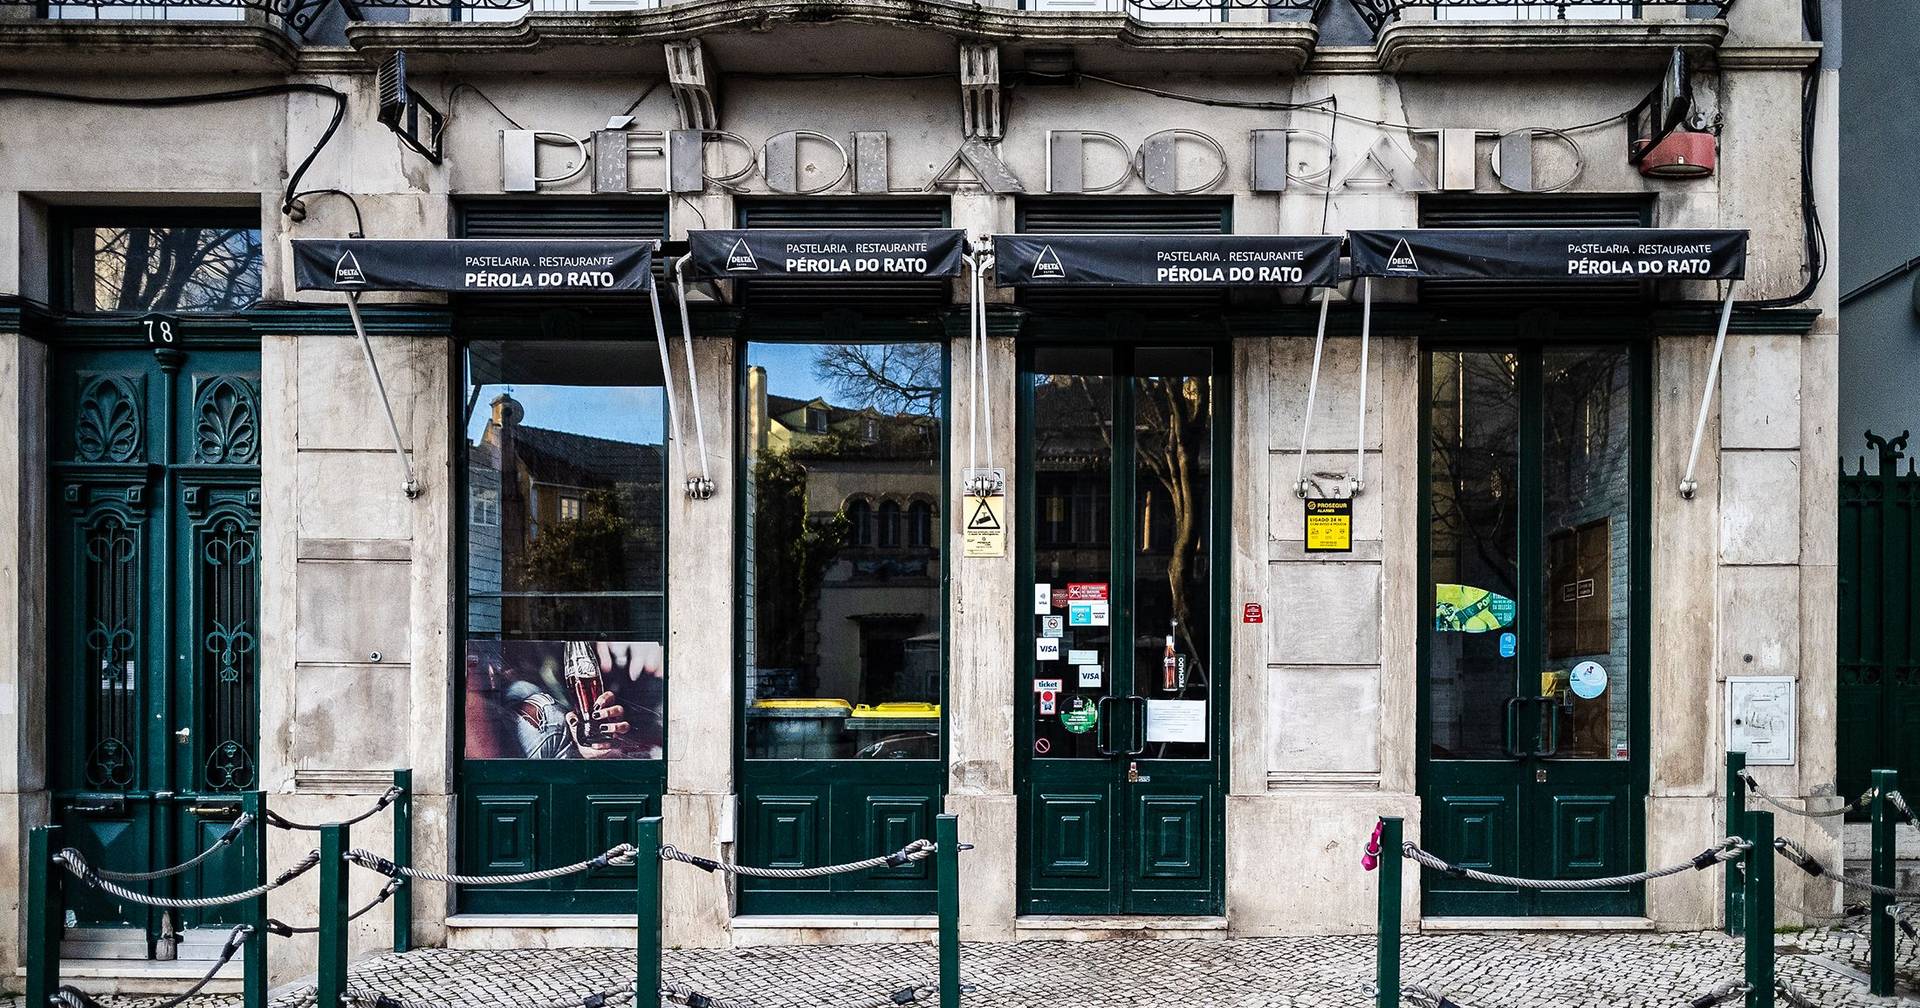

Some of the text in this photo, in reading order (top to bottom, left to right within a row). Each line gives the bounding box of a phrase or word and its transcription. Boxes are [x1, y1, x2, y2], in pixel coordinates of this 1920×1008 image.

[1046, 129, 1227, 194] DO
[1250, 127, 1584, 193] RATO
[786, 243, 847, 253] PASTELARIA
[855, 243, 927, 253] RESTAURANTE
[1568, 244, 1629, 254] PASTELARIA
[1638, 244, 1712, 254] RESTAURANTE
[465, 256, 530, 267] PASTELARIA
[539, 256, 614, 266] RESTAURANTE
[1157, 251, 1220, 262] PASTELARIA
[1229, 251, 1304, 262] RESTAURANTE
[1392, 257, 1413, 265] DELTA
[785, 257, 927, 273] PÉROLA DO RATO
[1038, 262, 1060, 270] DELTA
[1567, 257, 1711, 274] PÉROLA DO RATO
[338, 268, 359, 276] DELTA
[1157, 265, 1303, 282] PÉROLA DO RATO
[465, 270, 614, 287] PÉROLA DO RATO
[143, 320, 173, 343] 78
[1082, 672, 1099, 680] VISA
